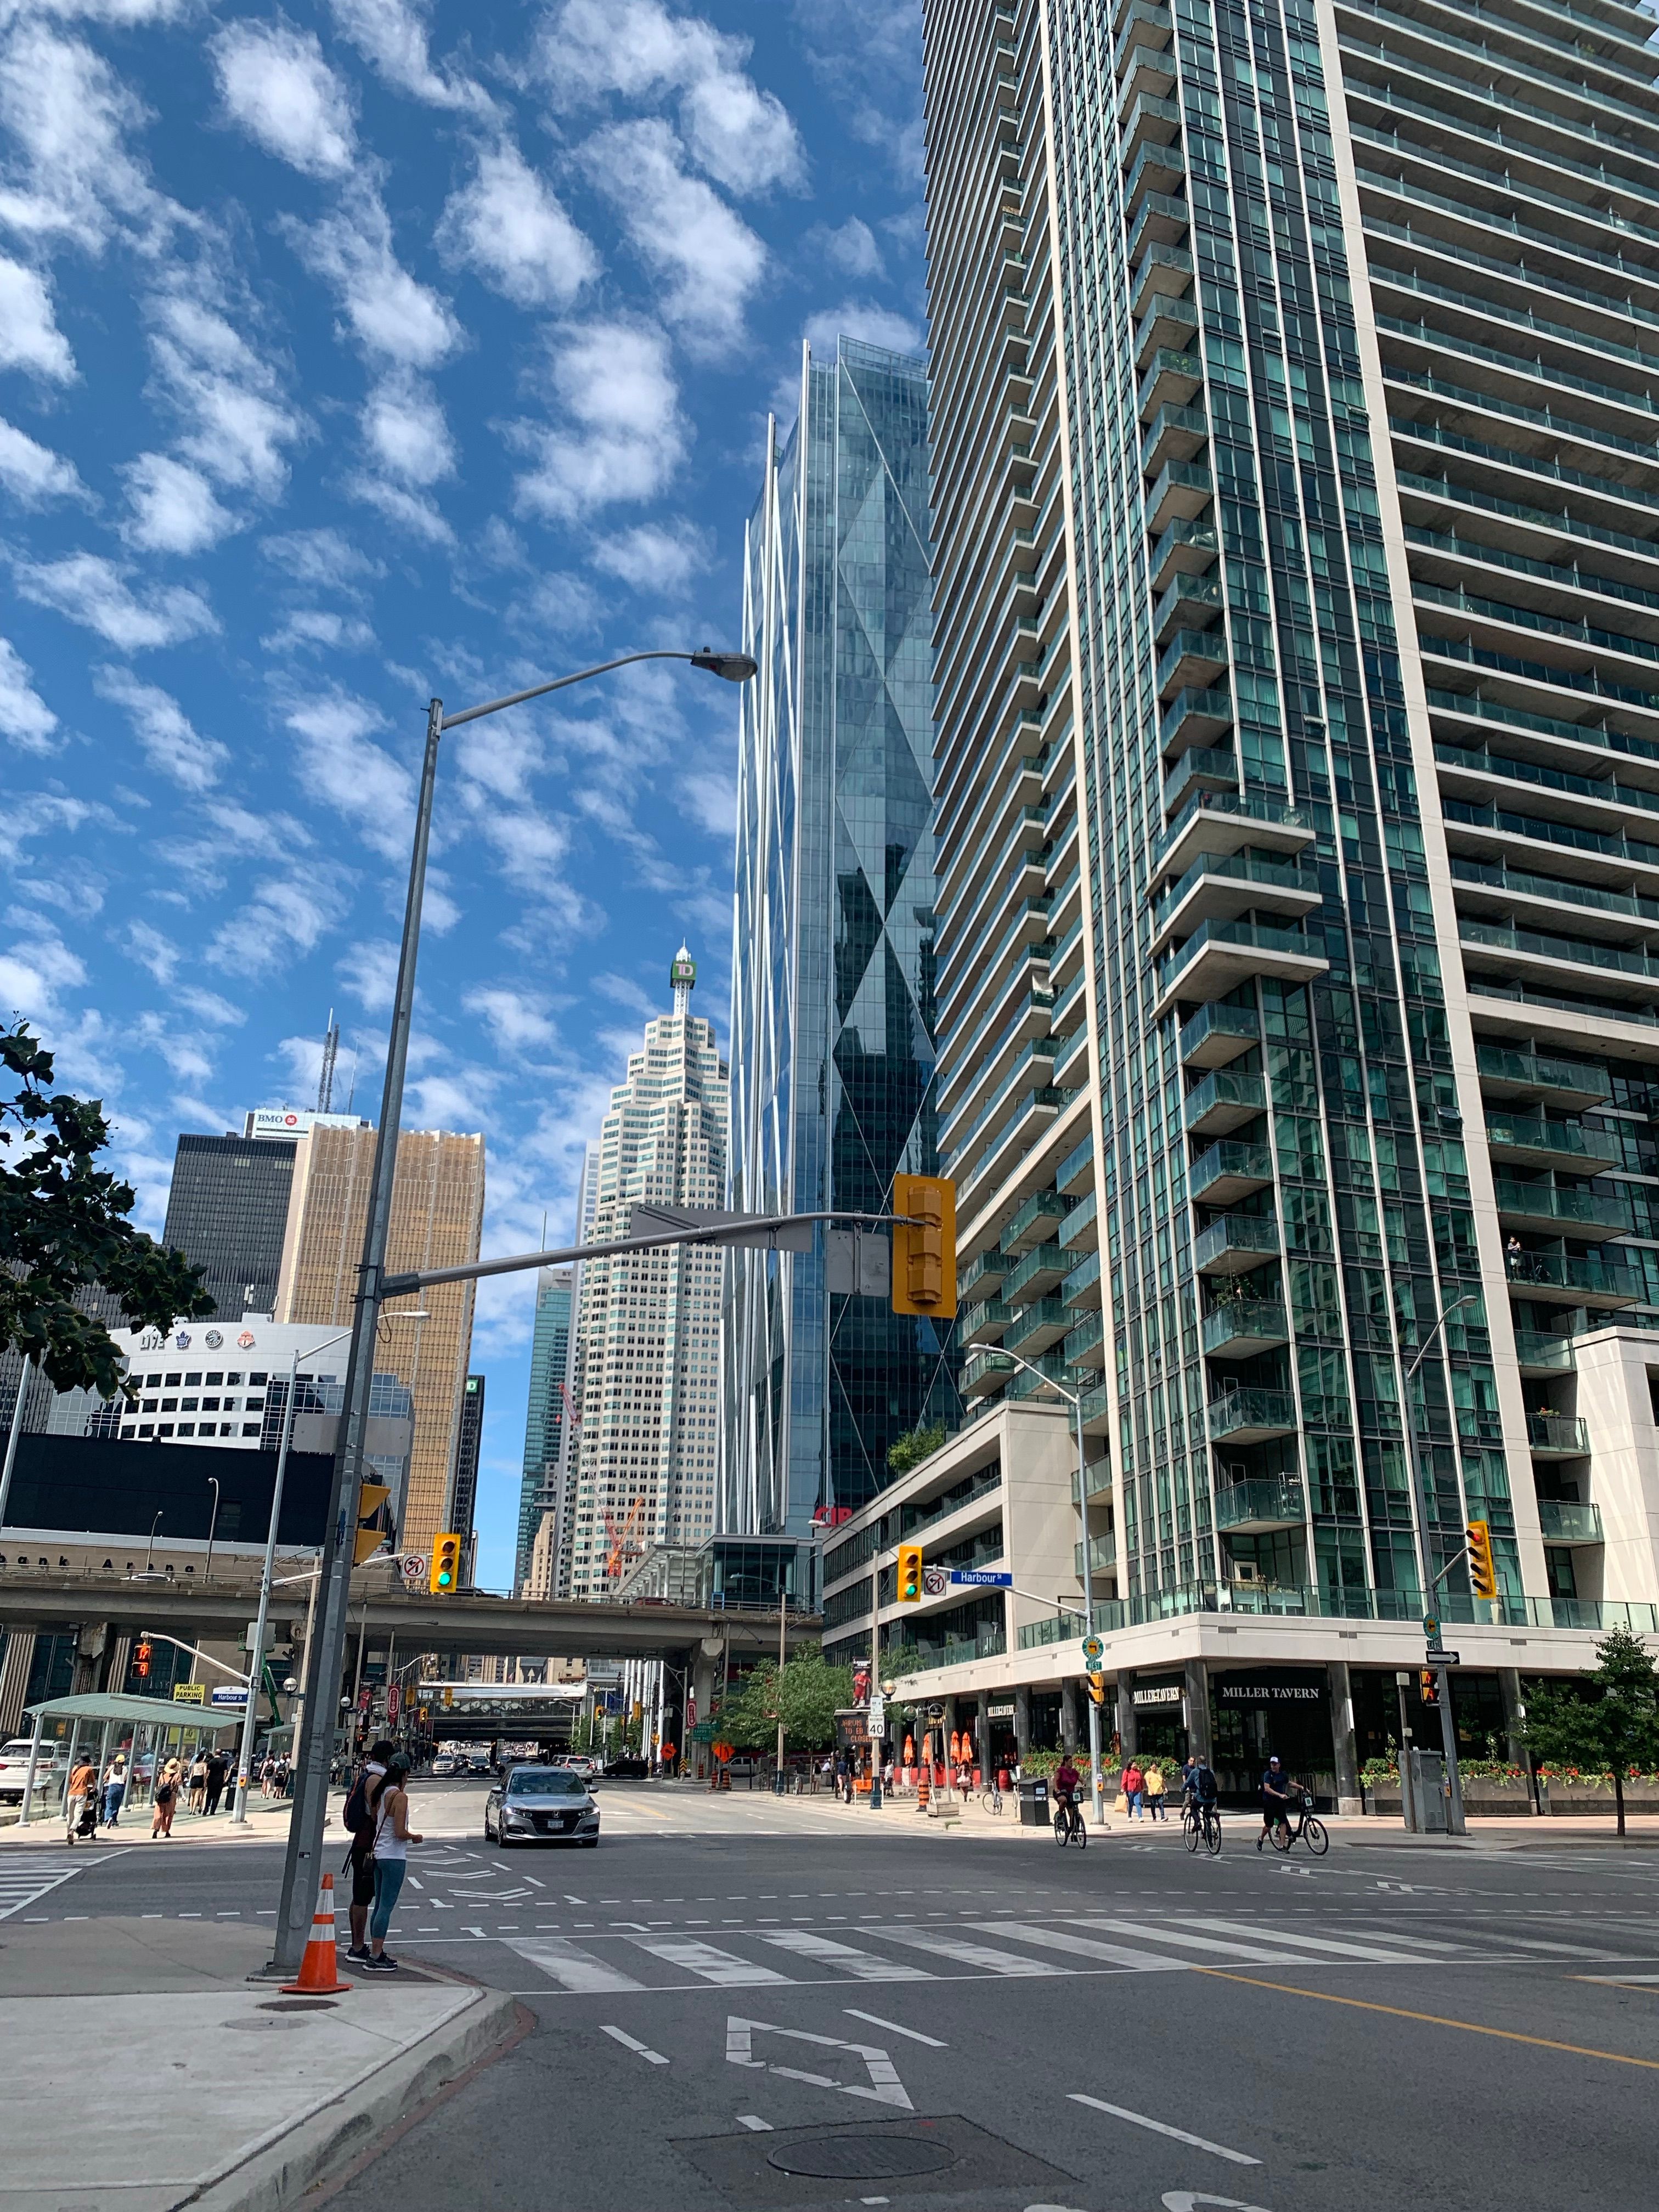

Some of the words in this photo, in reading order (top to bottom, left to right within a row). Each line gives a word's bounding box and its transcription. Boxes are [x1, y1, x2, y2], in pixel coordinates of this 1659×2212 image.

[675, 963, 693, 976] TD
[257, 1114, 283, 1123] BMO
[139, 1334, 165, 1350] LIVE
[102, 1559, 194, 1573] Arena
[961, 1572, 996, 1583] Harbour
[140, 1664, 145, 1675] 9
[1133, 1690, 1155, 1704] MILLER
[1155, 1686, 1180, 1702] TAVERN
[1222, 1687, 1270, 1697] MILLER
[1272, 1688, 1319, 1699] TAVERN
[870, 1724, 883, 1734] 40
